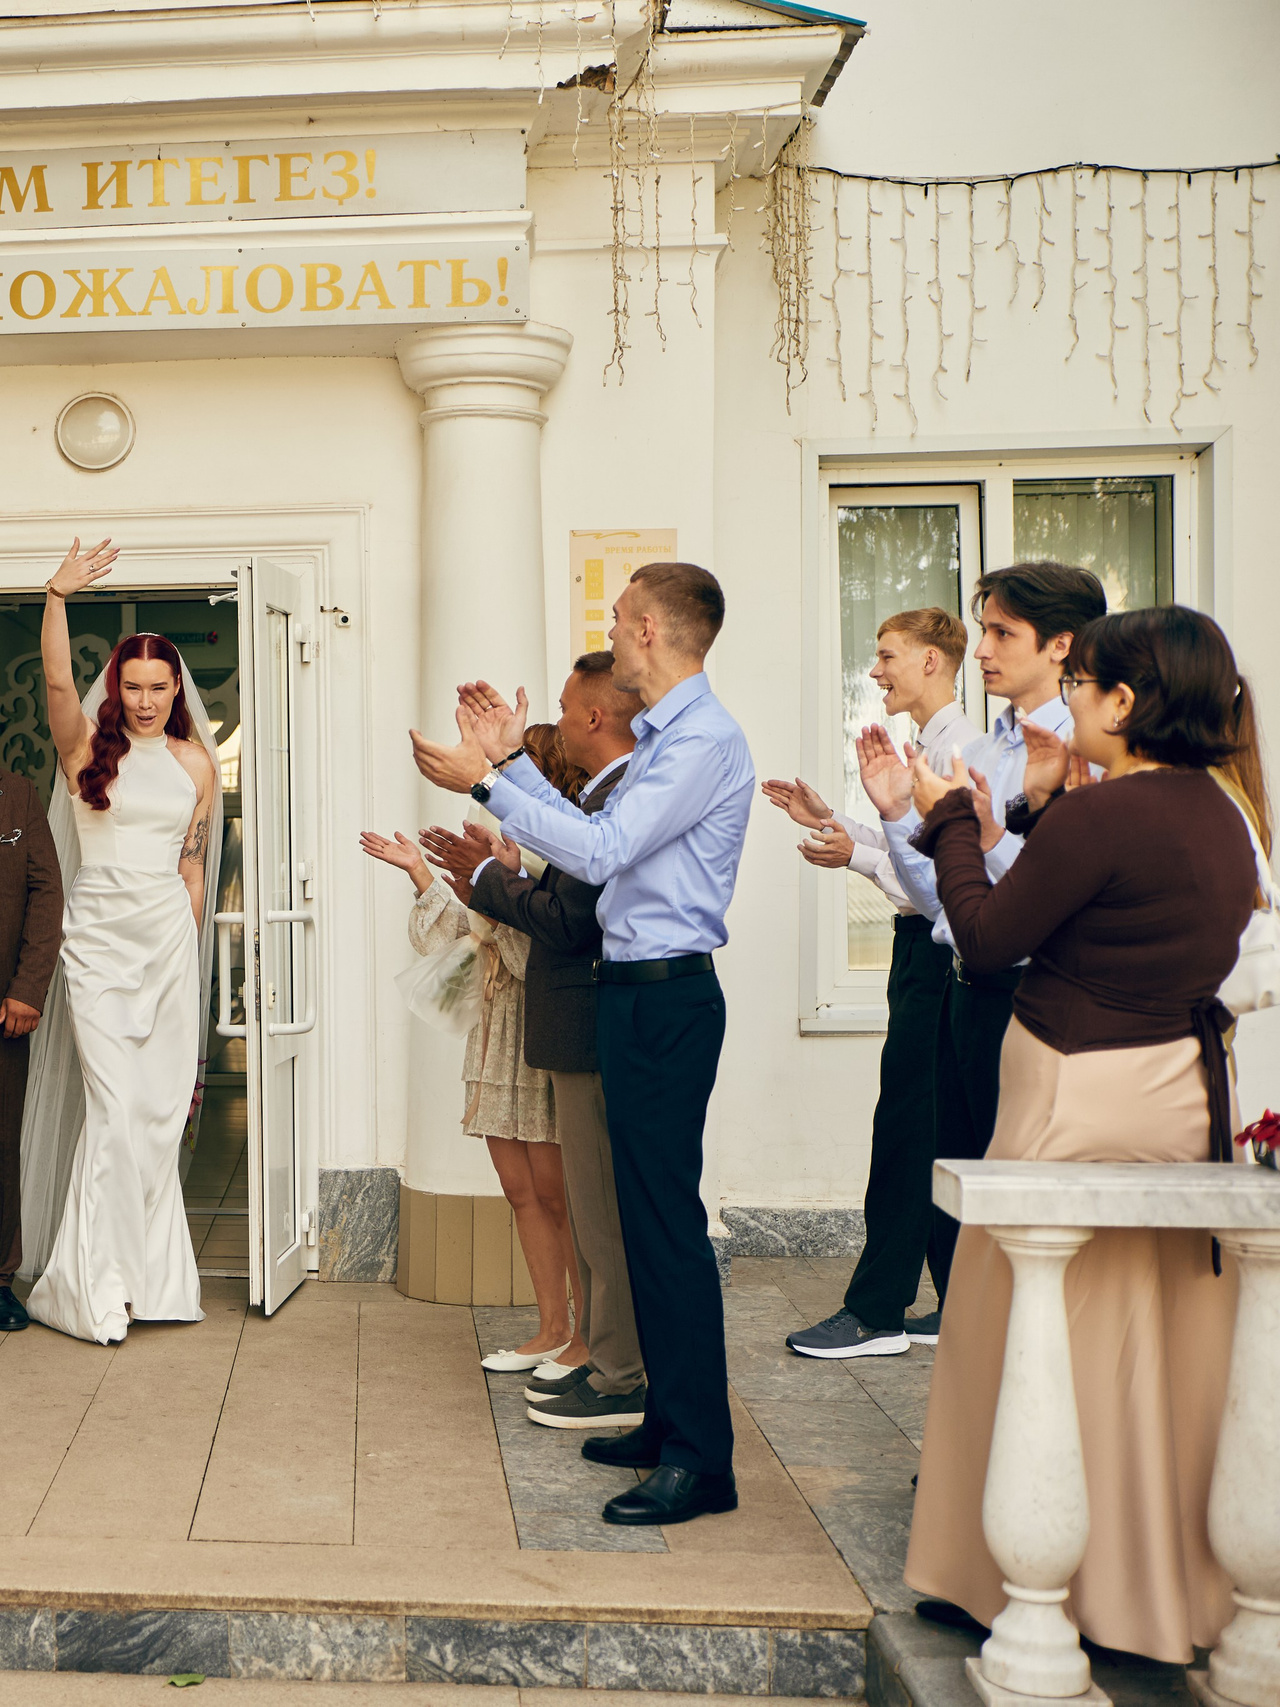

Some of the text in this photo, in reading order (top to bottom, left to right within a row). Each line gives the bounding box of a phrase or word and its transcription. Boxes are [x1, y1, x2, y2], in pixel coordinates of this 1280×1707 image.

[81, 149, 376, 210] ИТЕГЕҘ!
[605, 545, 671, 554] ВРЕМЯ РАБОТЫ
